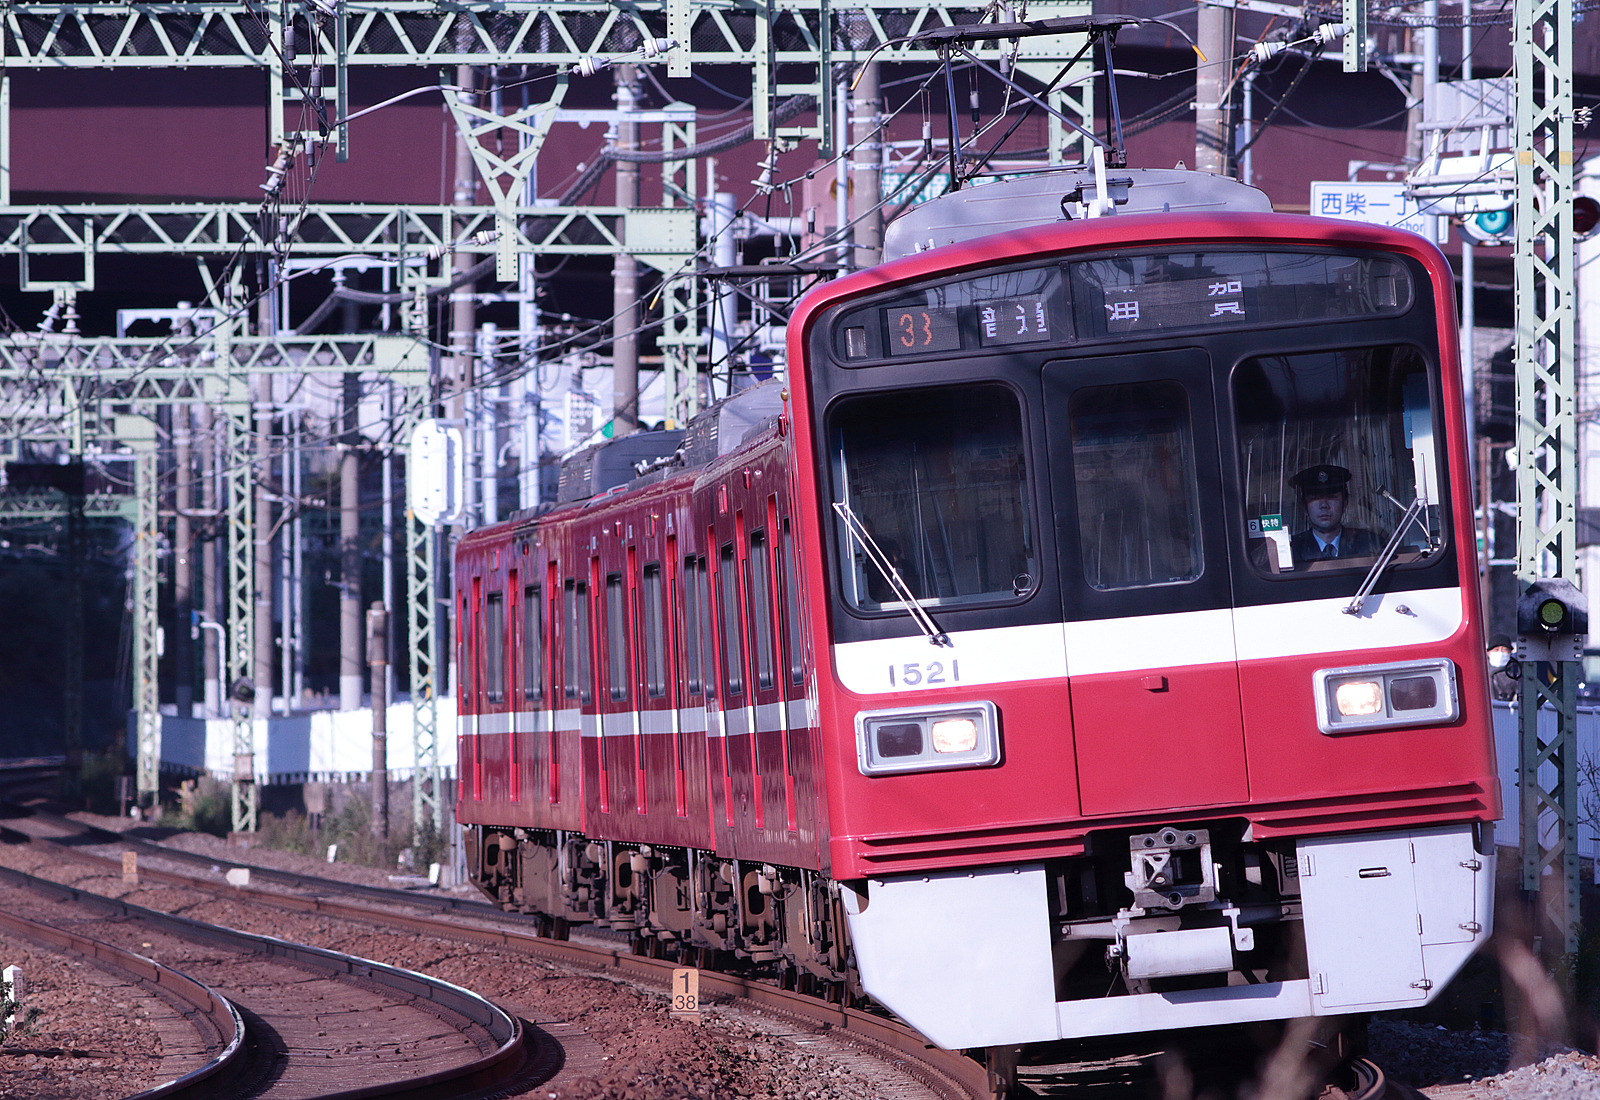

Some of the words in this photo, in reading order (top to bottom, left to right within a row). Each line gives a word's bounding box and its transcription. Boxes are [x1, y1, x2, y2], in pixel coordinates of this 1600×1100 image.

[1321, 192, 1423, 215] 西柴一丁
[889, 659, 959, 687] 1521
[680, 972, 689, 993] 1
[675, 995, 696, 1009] 38
